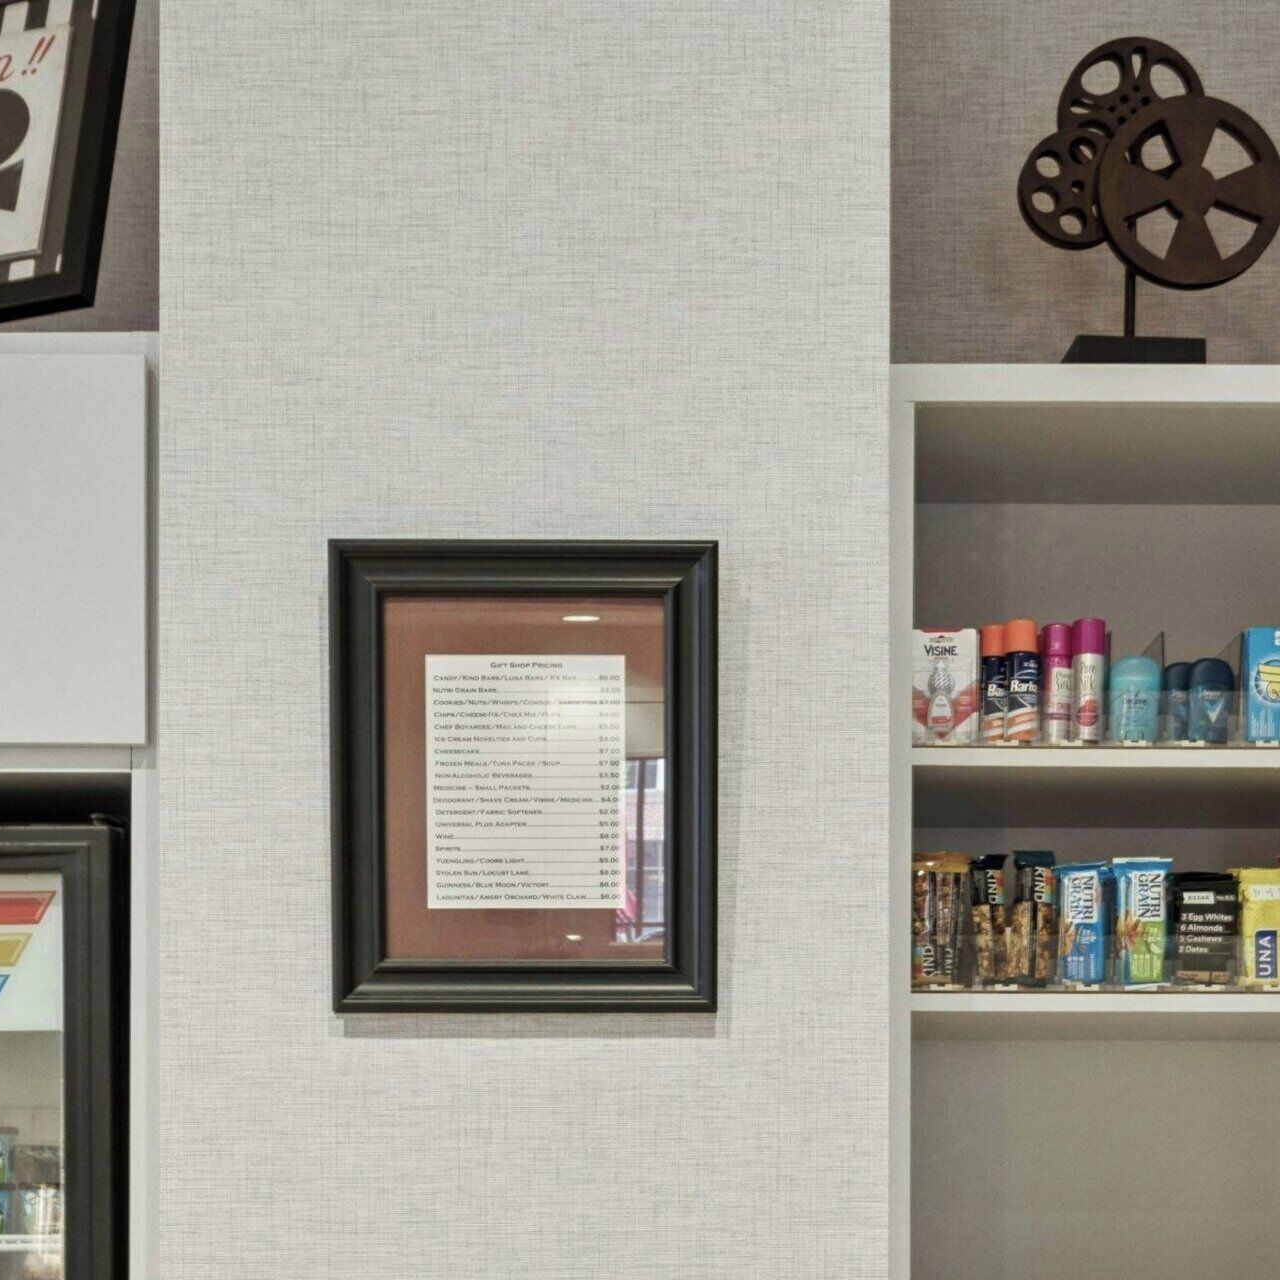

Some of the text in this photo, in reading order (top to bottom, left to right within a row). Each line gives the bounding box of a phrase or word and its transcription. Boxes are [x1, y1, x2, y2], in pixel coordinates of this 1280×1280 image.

[923, 644, 958, 656] VISINE
[986, 868, 997, 905] KIND
[1033, 866, 1044, 904] KIND
[1082, 875, 1095, 921] NUTRI
[1137, 873, 1148, 919] GRAIN
[1149, 873, 1161, 919] NUTRI
[1187, 924, 1223, 932] Almonds
[1188, 913, 1203, 922] Egg
[1205, 913, 1233, 921] Whites
[1186, 934, 1223, 942] Cashews
